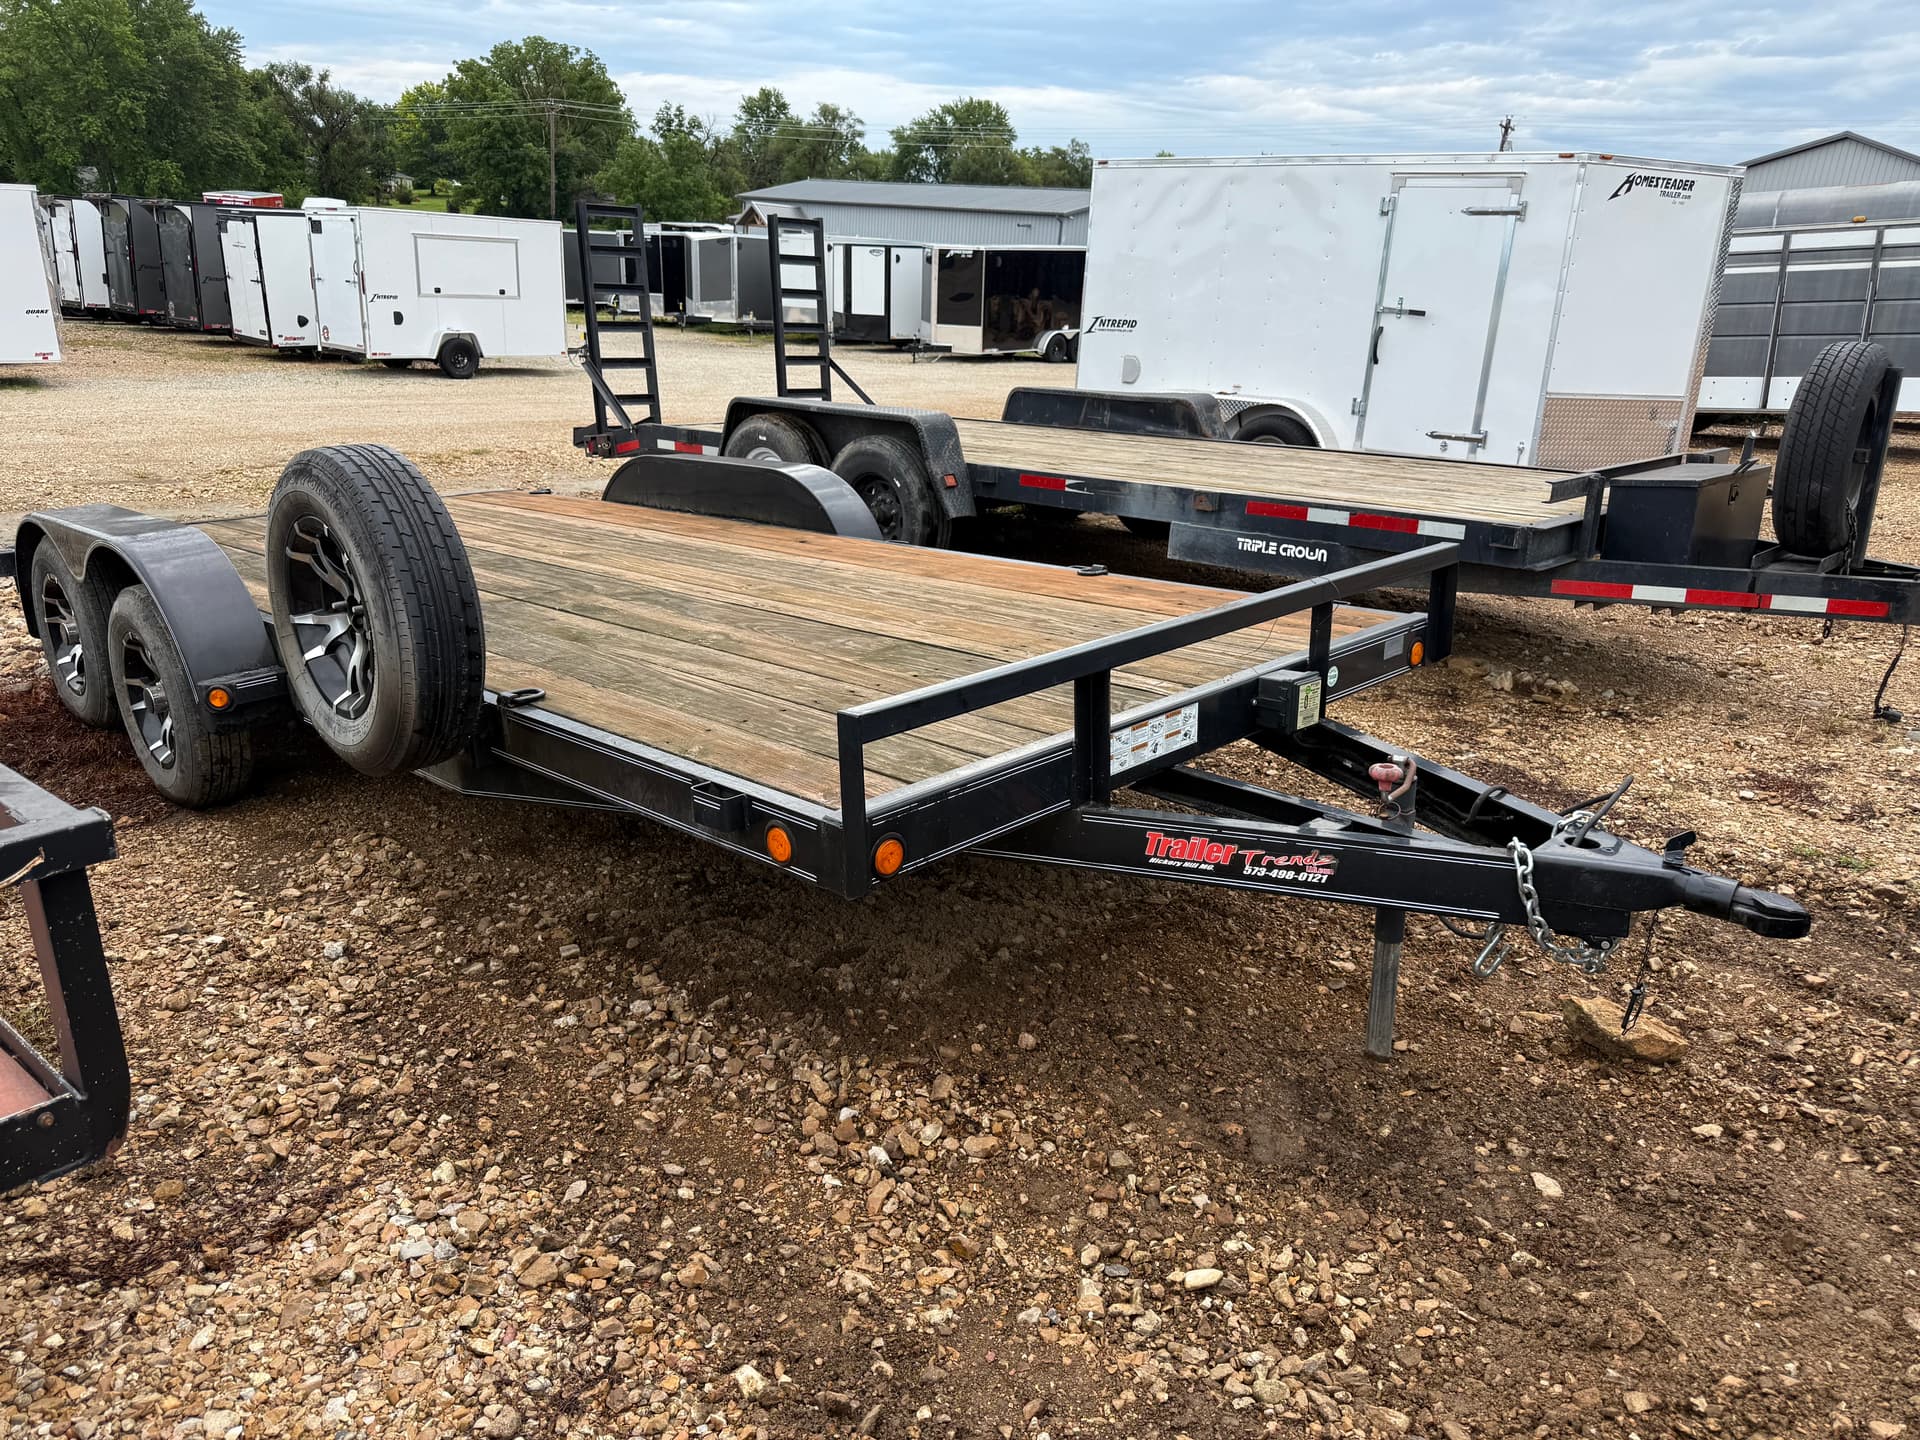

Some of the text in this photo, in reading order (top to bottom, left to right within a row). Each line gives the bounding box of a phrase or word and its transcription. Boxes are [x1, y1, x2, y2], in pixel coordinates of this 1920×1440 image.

[1607, 172, 1695, 200] HOMESTEADER
[1660, 190, 1691, 200] TRAILER.com
[1084, 316, 1137, 334] INTREPID
[1237, 537, 1328, 562] TRIPLE CROWN
[1145, 832, 1337, 867] Trailer Trendz
[1148, 857, 1183, 868] Hickory
[1182, 861, 1199, 870] Hill
[1243, 865, 1329, 884] 573-498-0121
